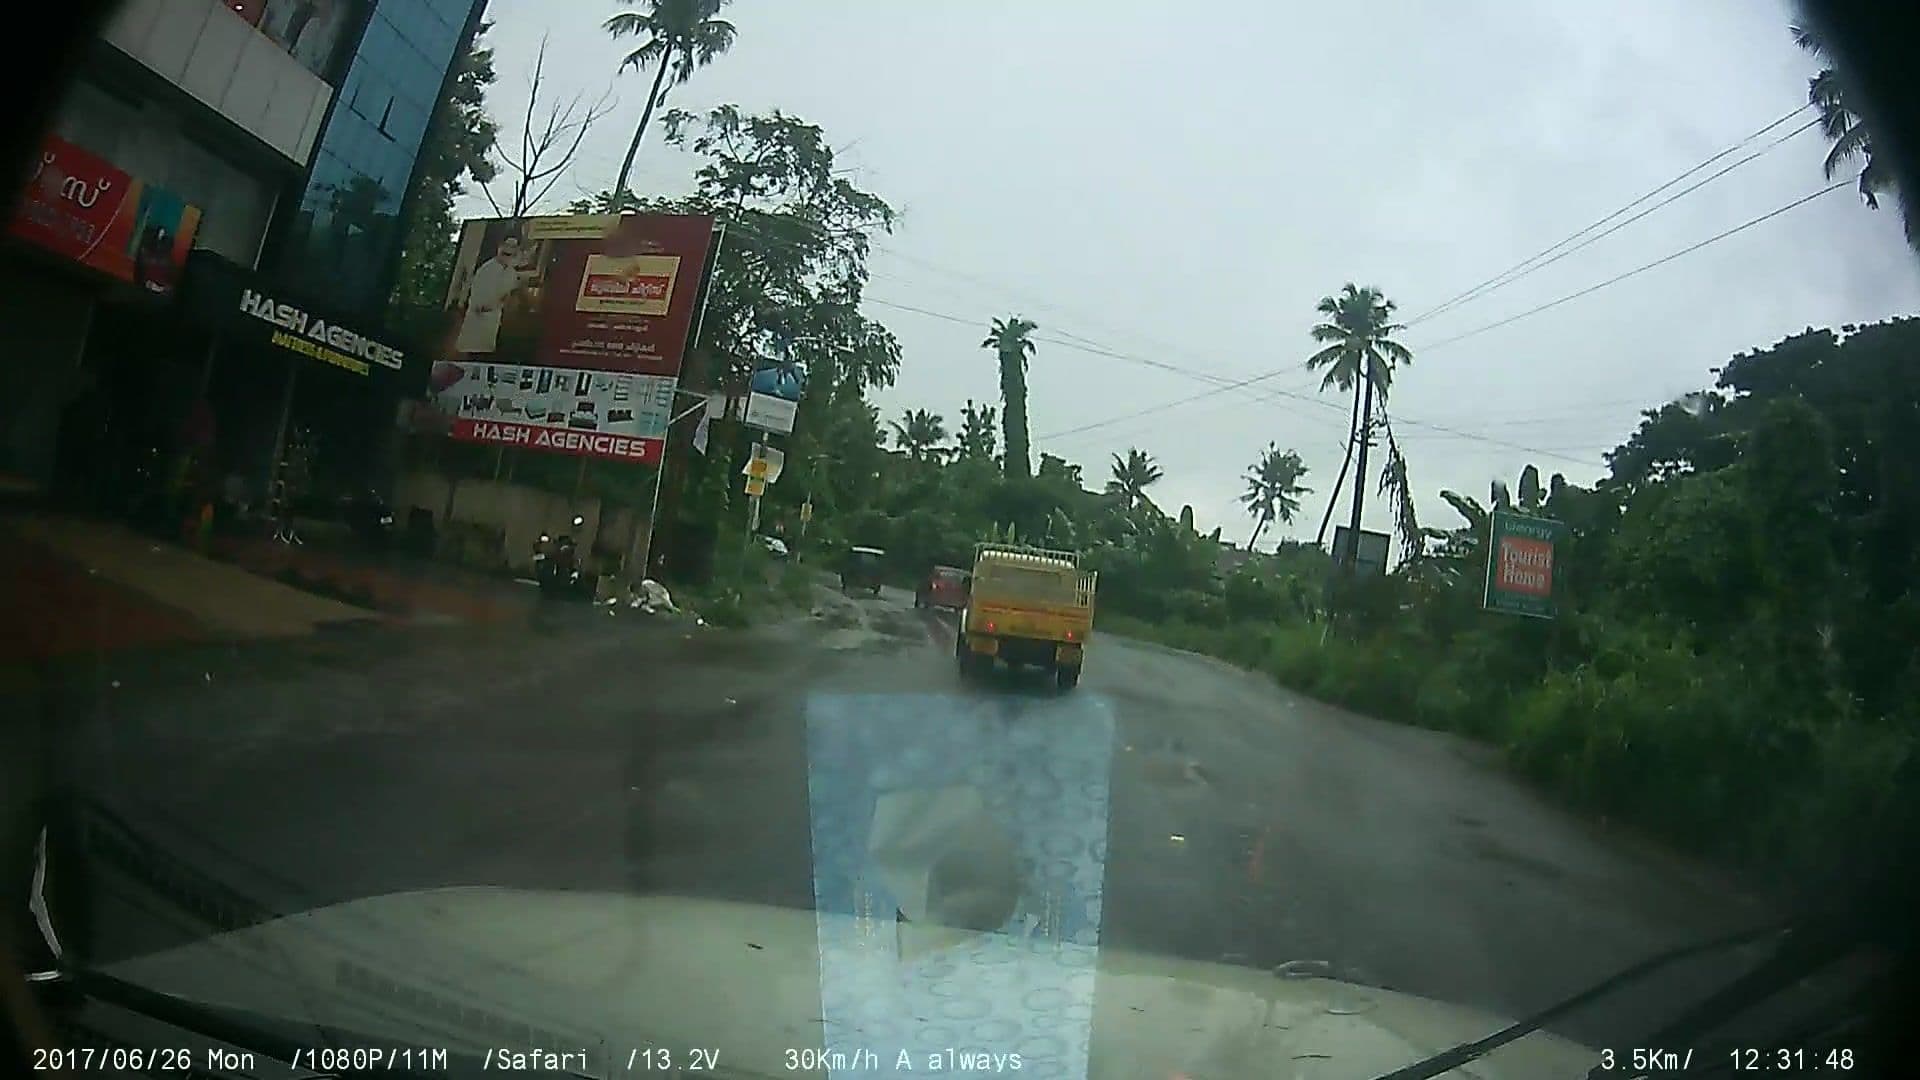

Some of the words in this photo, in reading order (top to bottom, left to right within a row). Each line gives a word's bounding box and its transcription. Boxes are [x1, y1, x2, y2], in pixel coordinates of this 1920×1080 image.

[239, 288, 309, 335] HASH
[307, 318, 404, 371] AGENCIES
[473, 422, 531, 444] HASH
[534, 429, 646, 457] AGENCIES
[1502, 542, 1552, 569] Tourist
[1503, 560, 1545, 590] Home
